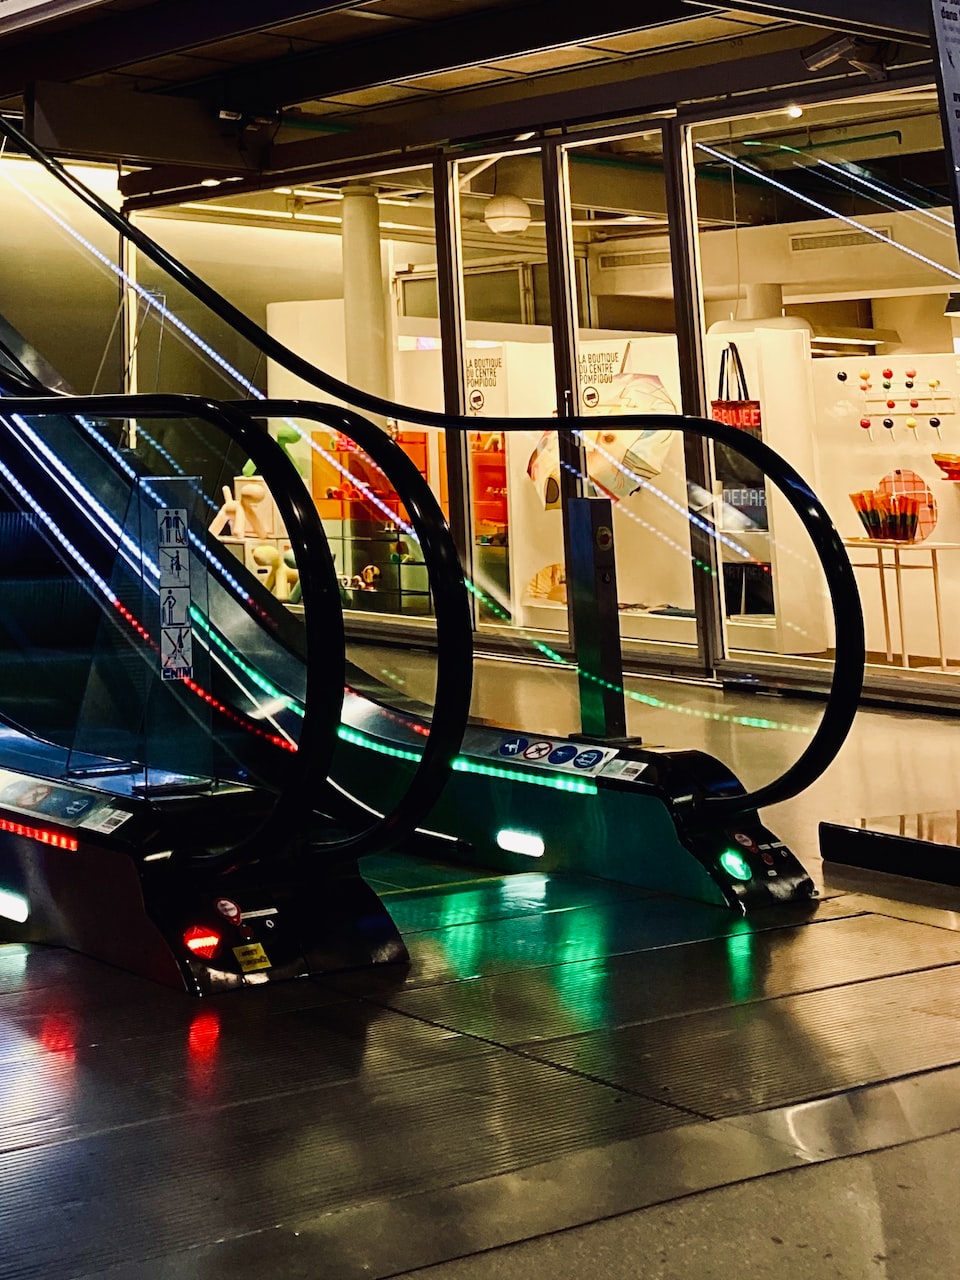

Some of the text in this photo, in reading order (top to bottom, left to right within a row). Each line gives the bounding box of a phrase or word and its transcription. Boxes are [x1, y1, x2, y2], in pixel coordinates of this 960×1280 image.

[465, 358, 502, 368] LA BOUTIQUE
[578, 352, 620, 364] LA BOUTIQUE
[475, 367, 497, 378] CENTRE
[589, 362, 613, 373] CENTRE
[466, 377, 497, 388] POMPIDOU
[580, 374, 613, 384] POMPIDOU
